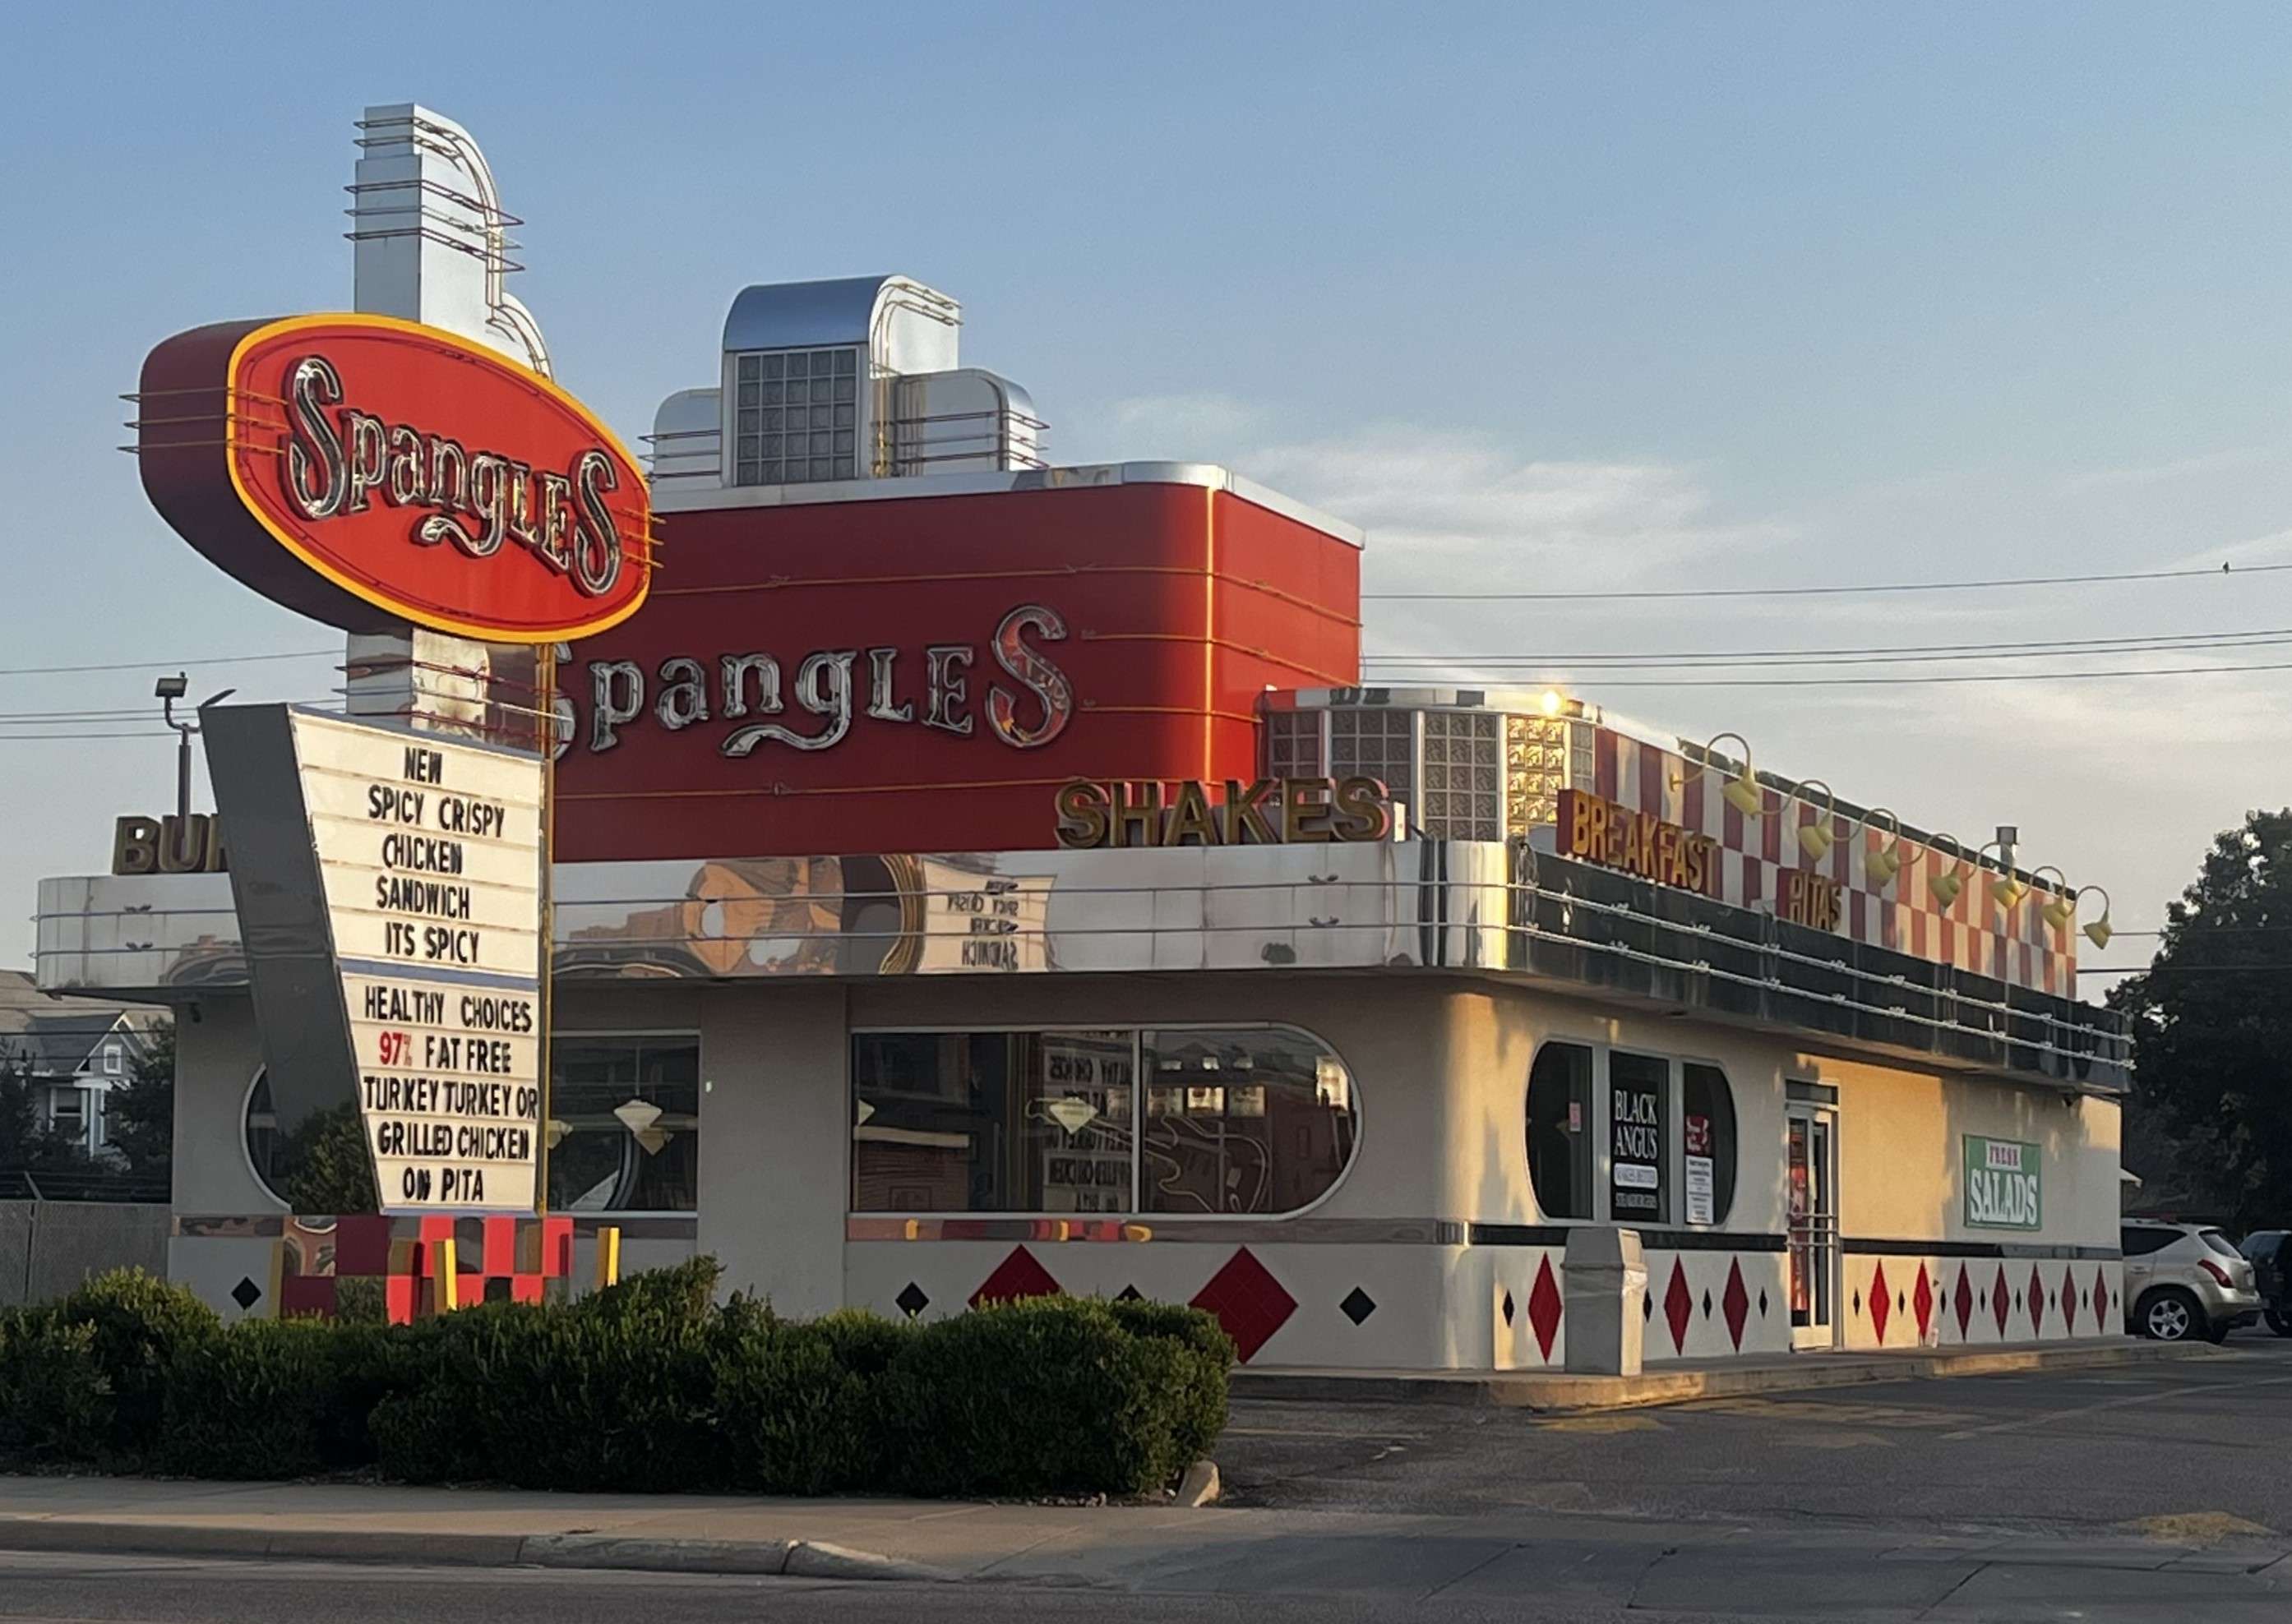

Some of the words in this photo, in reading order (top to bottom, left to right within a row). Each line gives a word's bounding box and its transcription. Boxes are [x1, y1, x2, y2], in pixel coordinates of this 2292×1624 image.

[404, 746, 442, 784] NEW
[368, 784, 424, 825] SPICY
[438, 796, 505, 838] CRISPY
[1055, 777, 1389, 849] SHAKES
[382, 833, 462, 874] CHICKEN
[1569, 790, 1722, 897] BREAKFAST
[376, 875, 469, 920] SANDWICH
[386, 921, 415, 957] ITS
[424, 928, 479, 964] SPICY
[365, 985, 445, 1025] HEALTHY
[460, 995, 533, 1033] CHOICES
[425, 1036, 460, 1069] FAT
[466, 1039, 511, 1073] FREE
[363, 1075, 439, 1112] TURKEY
[443, 1080, 511, 1116] TURKEY
[516, 1086, 538, 1119] OR
[1615, 1089, 1658, 1125] BLACK
[378, 1121, 452, 1156] GRILLED
[458, 1125, 529, 1160] CHICKEN
[1614, 1125, 1658, 1160] ANGUS
[403, 1166, 432, 1201] ON
[441, 1167, 483, 1202] PITA
[1970, 1168, 2037, 1225] SALADS
